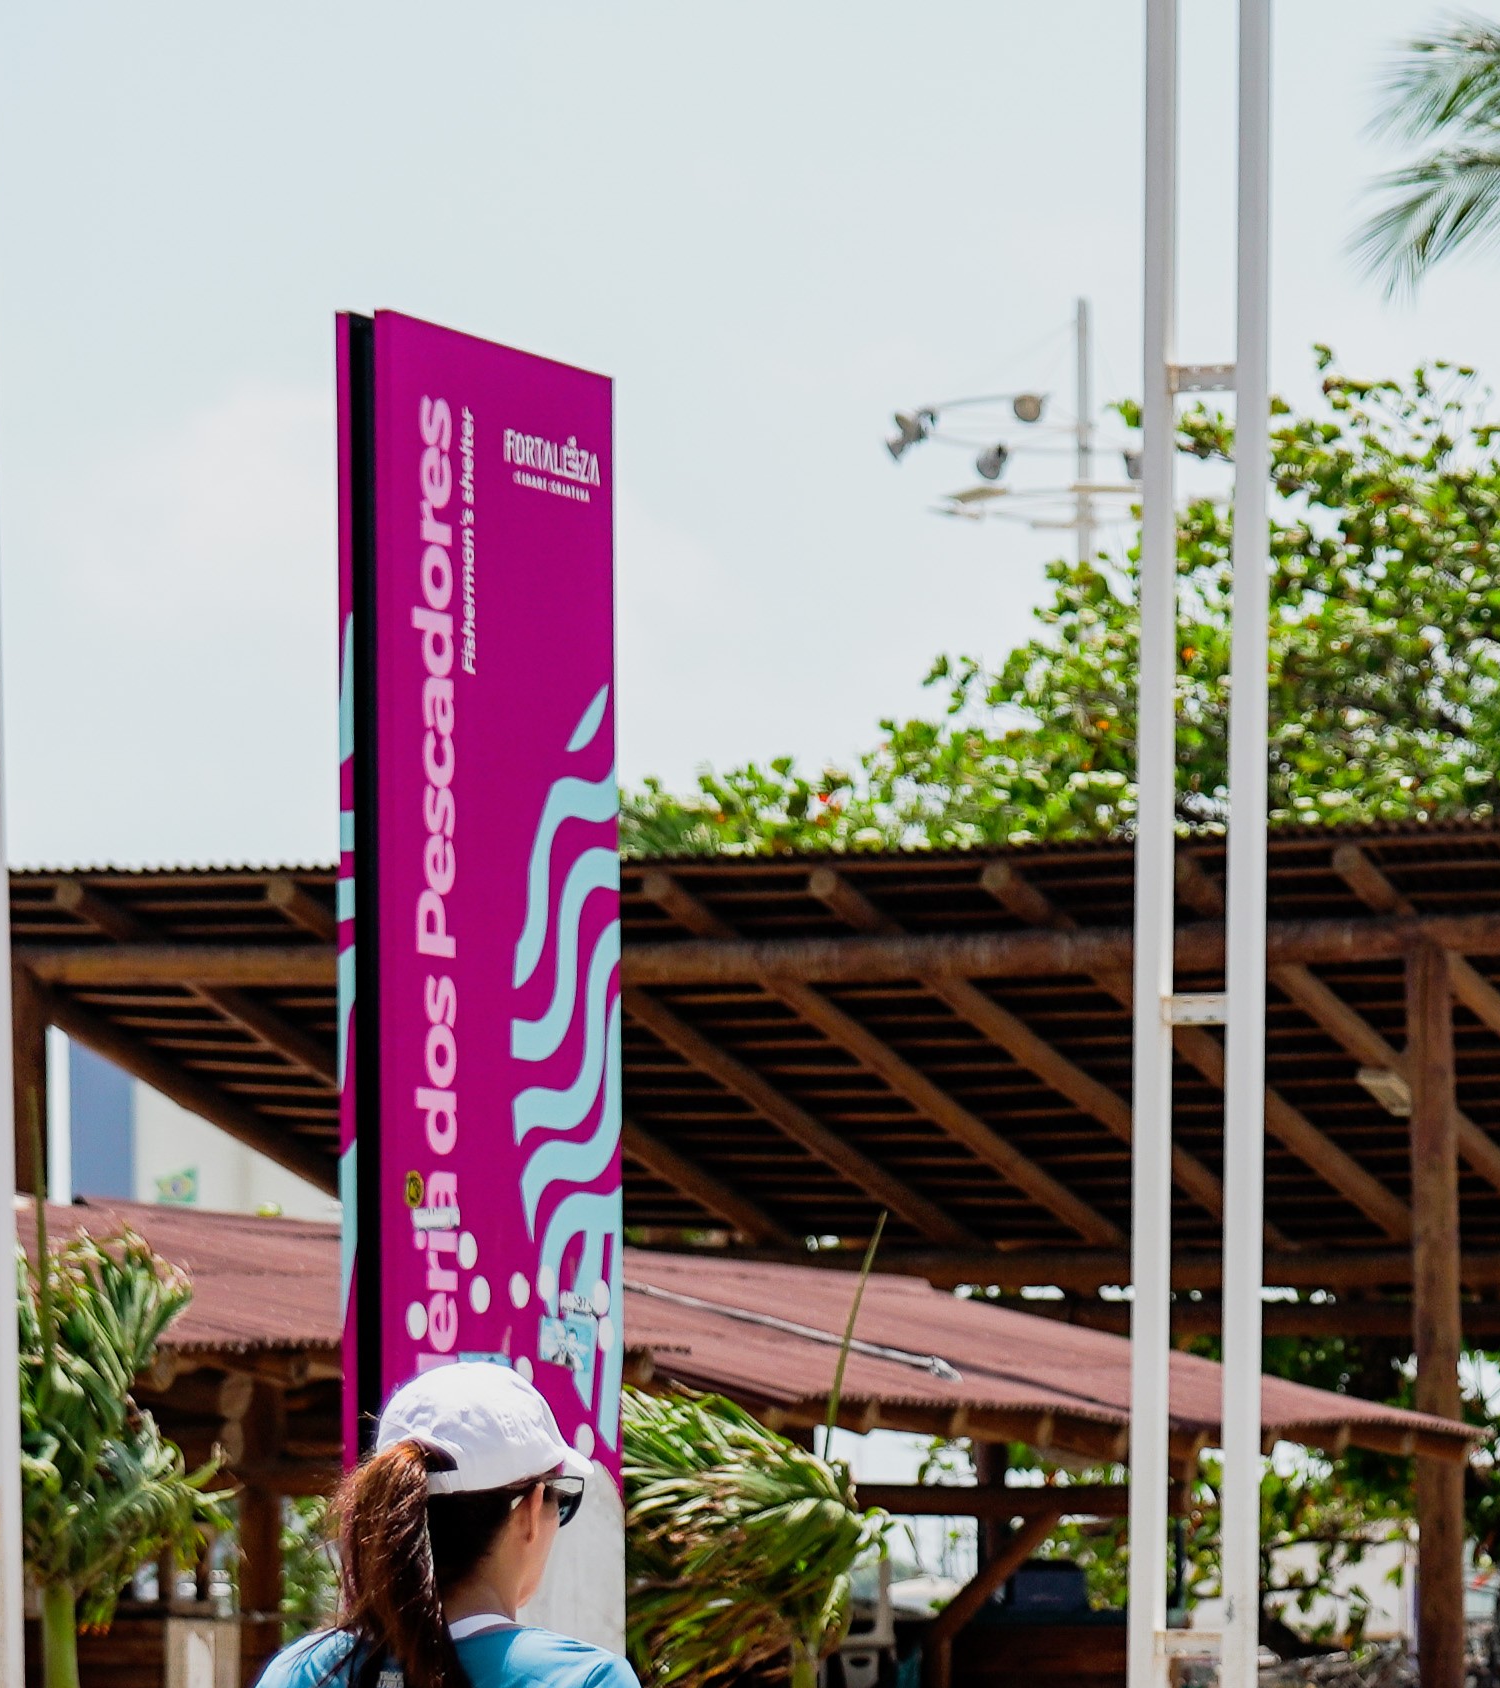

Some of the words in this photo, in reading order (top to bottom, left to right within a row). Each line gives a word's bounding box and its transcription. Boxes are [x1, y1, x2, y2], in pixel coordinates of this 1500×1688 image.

[459, 405, 475, 505] shelter
[503, 427, 601, 488] FORTALEZA
[459, 507, 476, 676] Fisherman's
[411, 394, 457, 959] Pescadores
[415, 975, 458, 1156] dos
